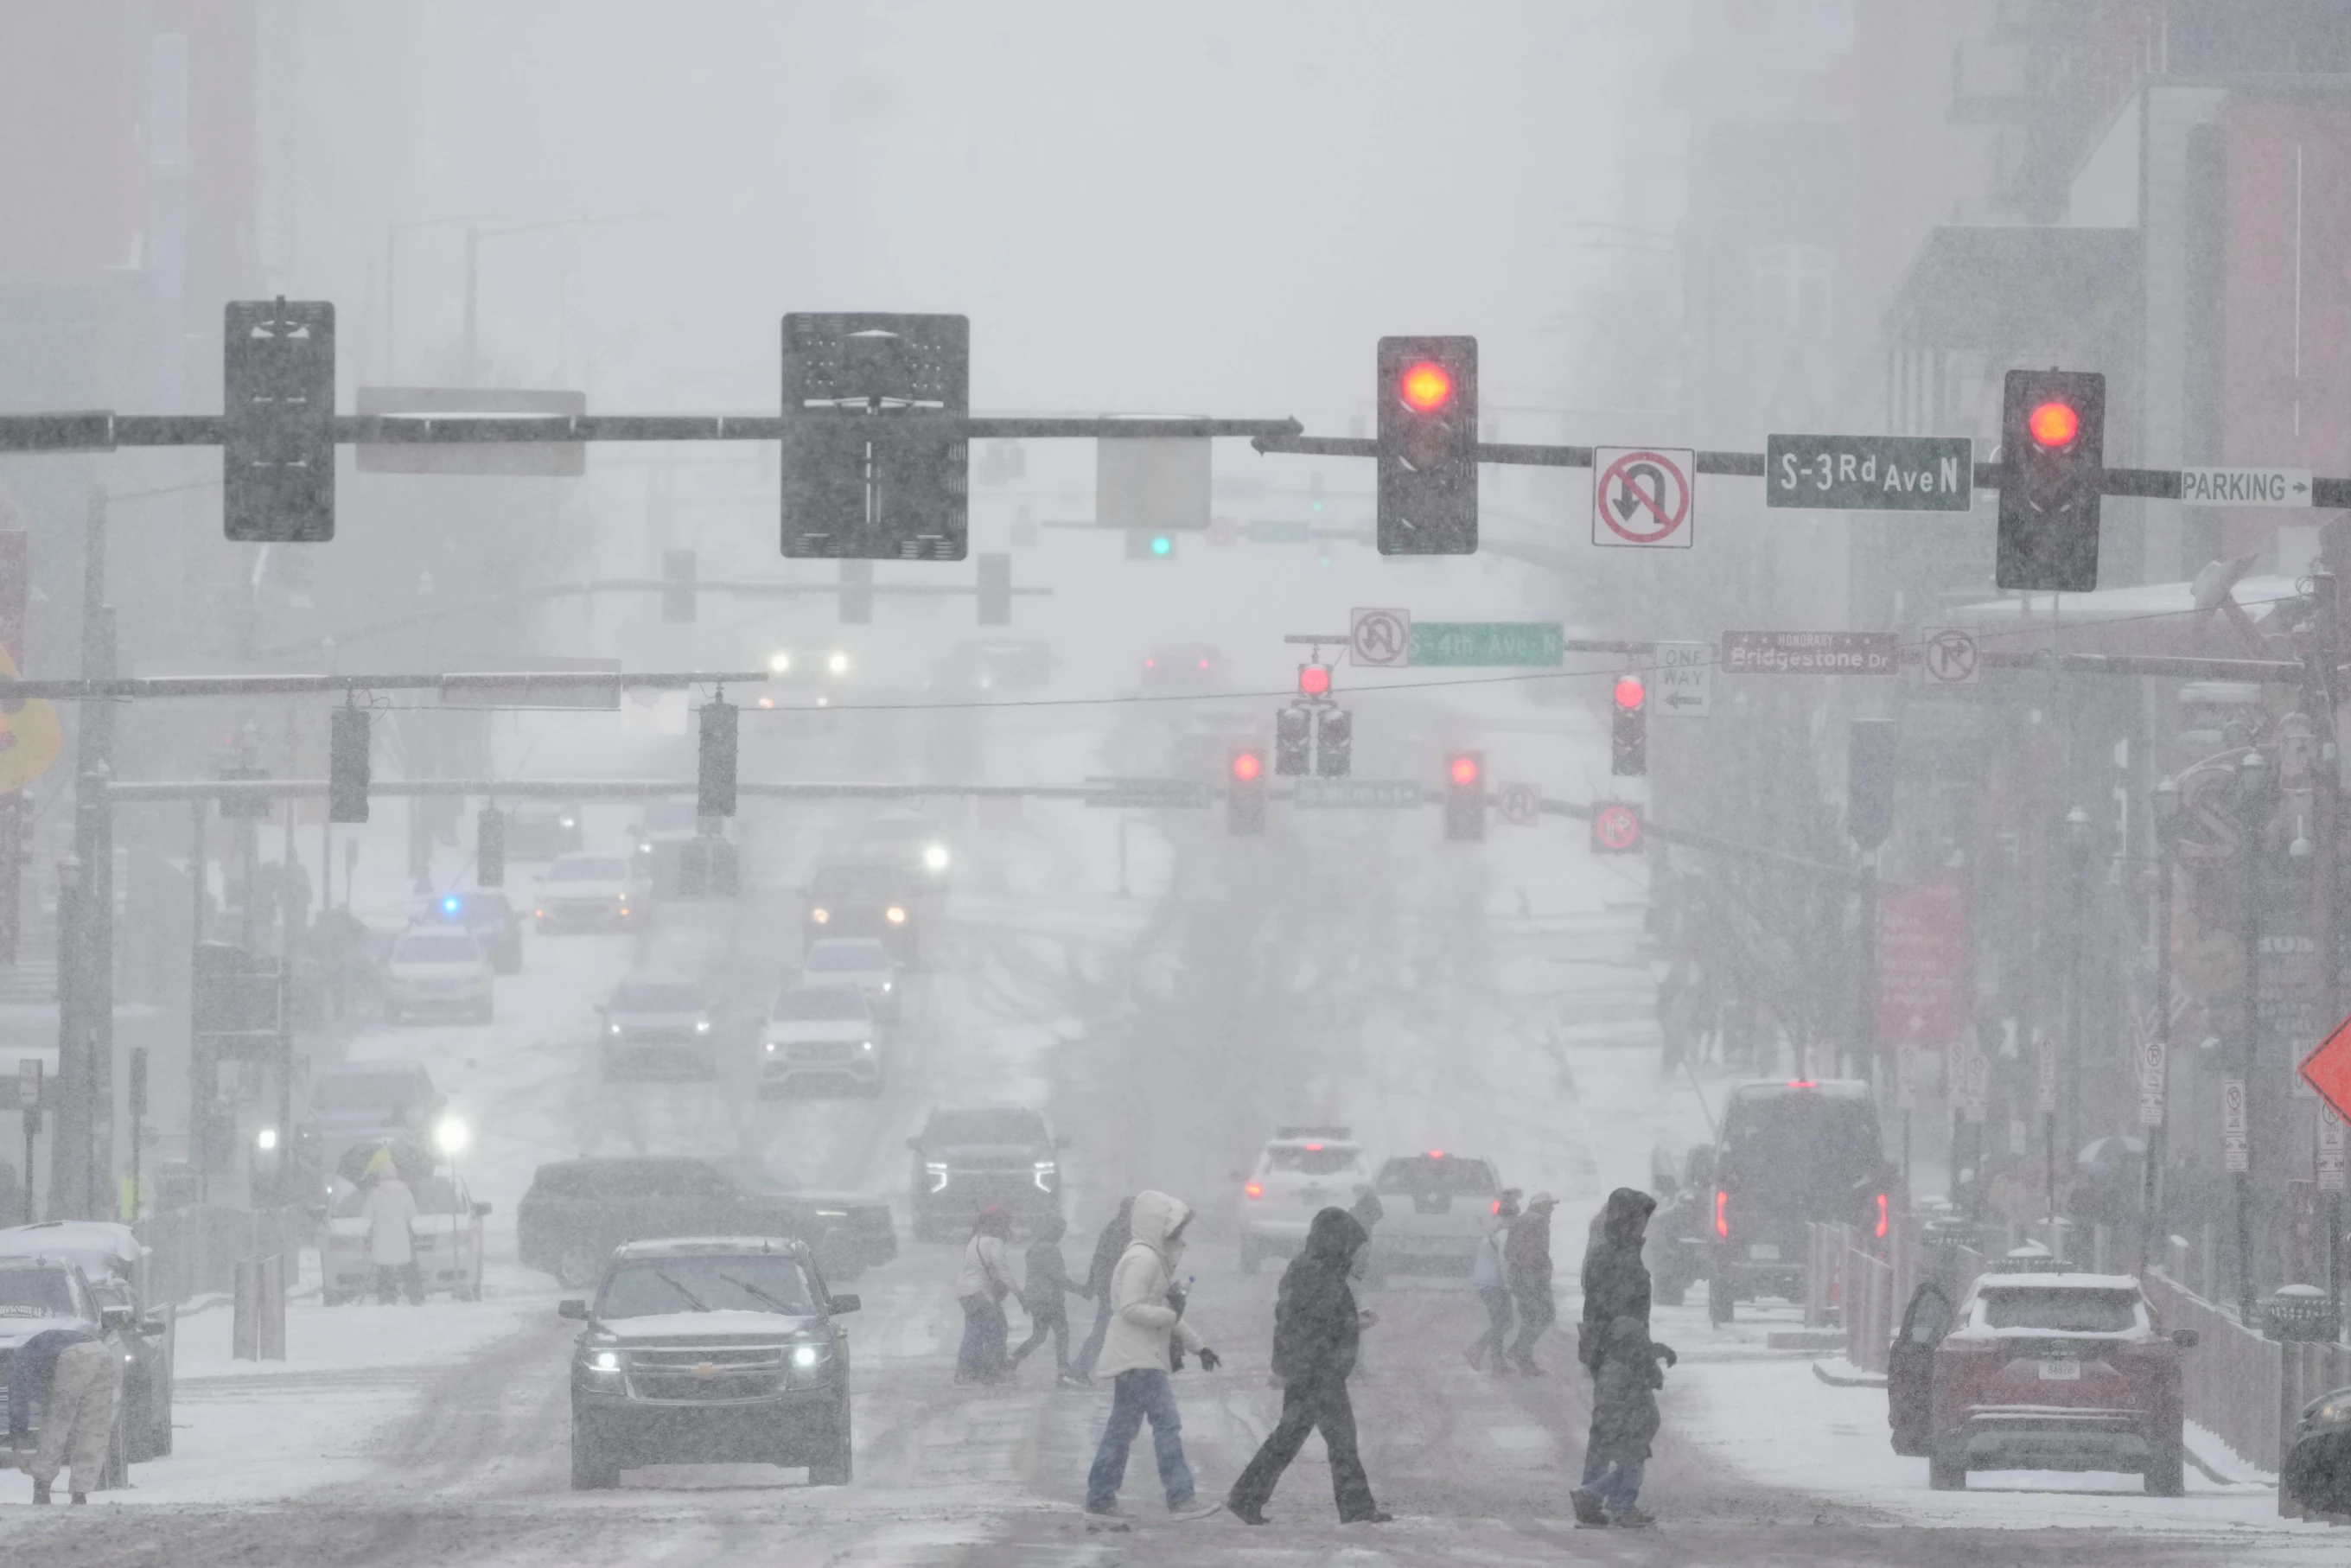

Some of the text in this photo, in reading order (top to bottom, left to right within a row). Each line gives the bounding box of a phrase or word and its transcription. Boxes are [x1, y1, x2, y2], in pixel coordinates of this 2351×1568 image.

[1883, 463, 1934, 493] Ave
[1940, 456, 1958, 493] N
[2182, 471, 2285, 501] PARKING
[1778, 634, 1834, 647] HONORARY
[1666, 649, 1703, 666] ONE
[1731, 647, 1889, 671] Bridgestone Dr
[1664, 669, 1704, 686] WAY
